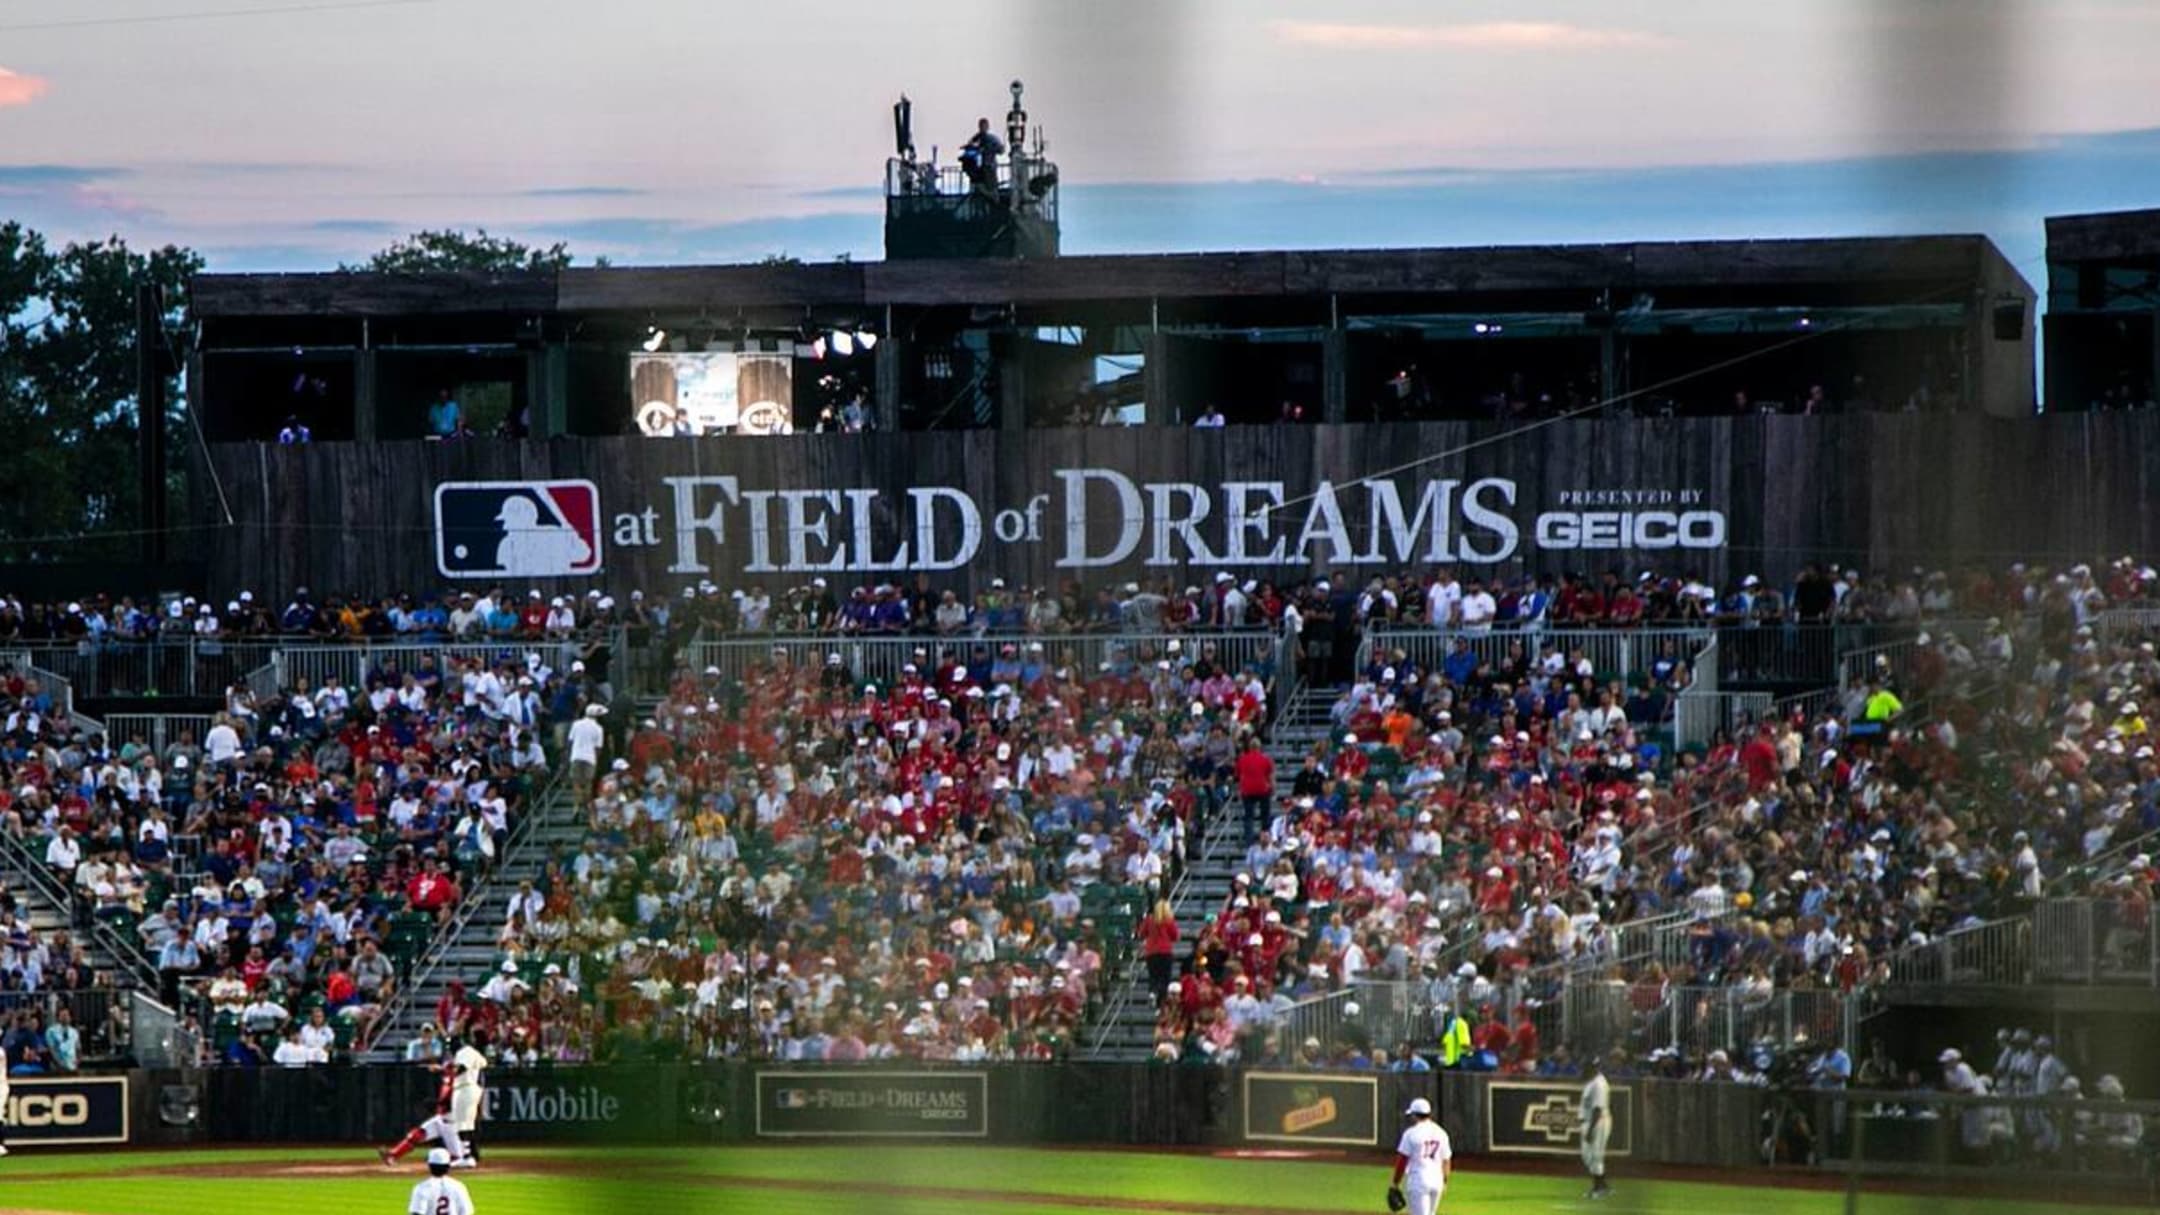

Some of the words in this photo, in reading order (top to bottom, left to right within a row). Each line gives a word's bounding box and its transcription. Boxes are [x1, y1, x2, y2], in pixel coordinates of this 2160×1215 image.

[1560, 490, 1672, 505] PRESENTED
[1680, 489, 1703, 504] BY
[614, 506, 660, 547] at
[664, 475, 982, 574] FIELD
[994, 496, 1048, 542] of
[1055, 468, 1519, 567] DREAMS
[1536, 510, 1726, 549] GEICO
[3, 1094, 89, 1126] ICO
[508, 1086, 619, 1121] Mobile
[887, 1089, 967, 1109] DREAMS
[1423, 1140, 1440, 1159] 17
[436, 1196, 449, 1215] 2
